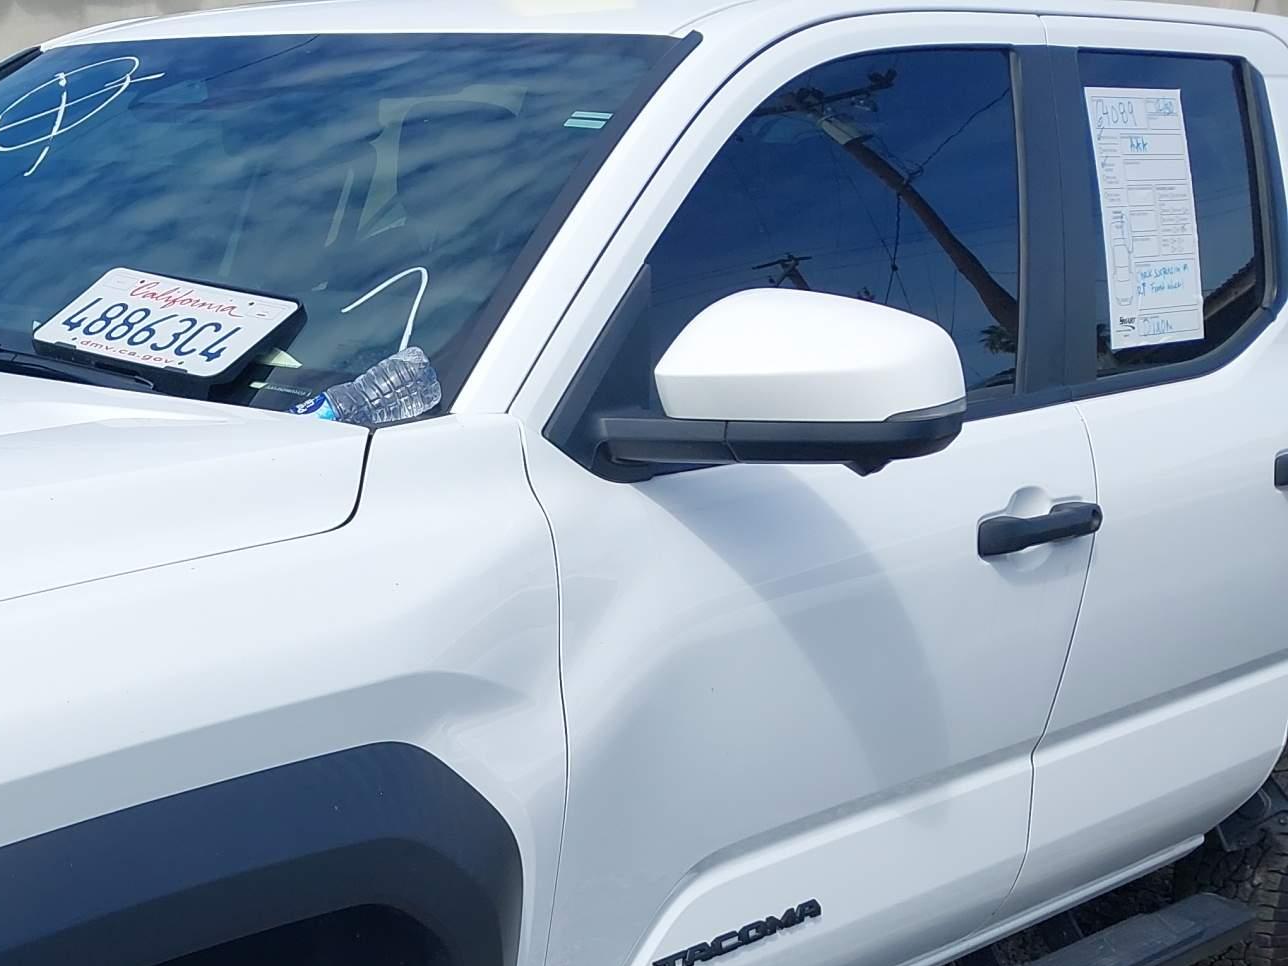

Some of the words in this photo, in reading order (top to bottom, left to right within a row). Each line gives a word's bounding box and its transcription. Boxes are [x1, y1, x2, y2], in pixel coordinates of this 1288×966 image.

[129, 281, 244, 318] California
[61, 297, 242, 363] 48863C4
[79, 339, 177, 365] dmv.ca.gov
